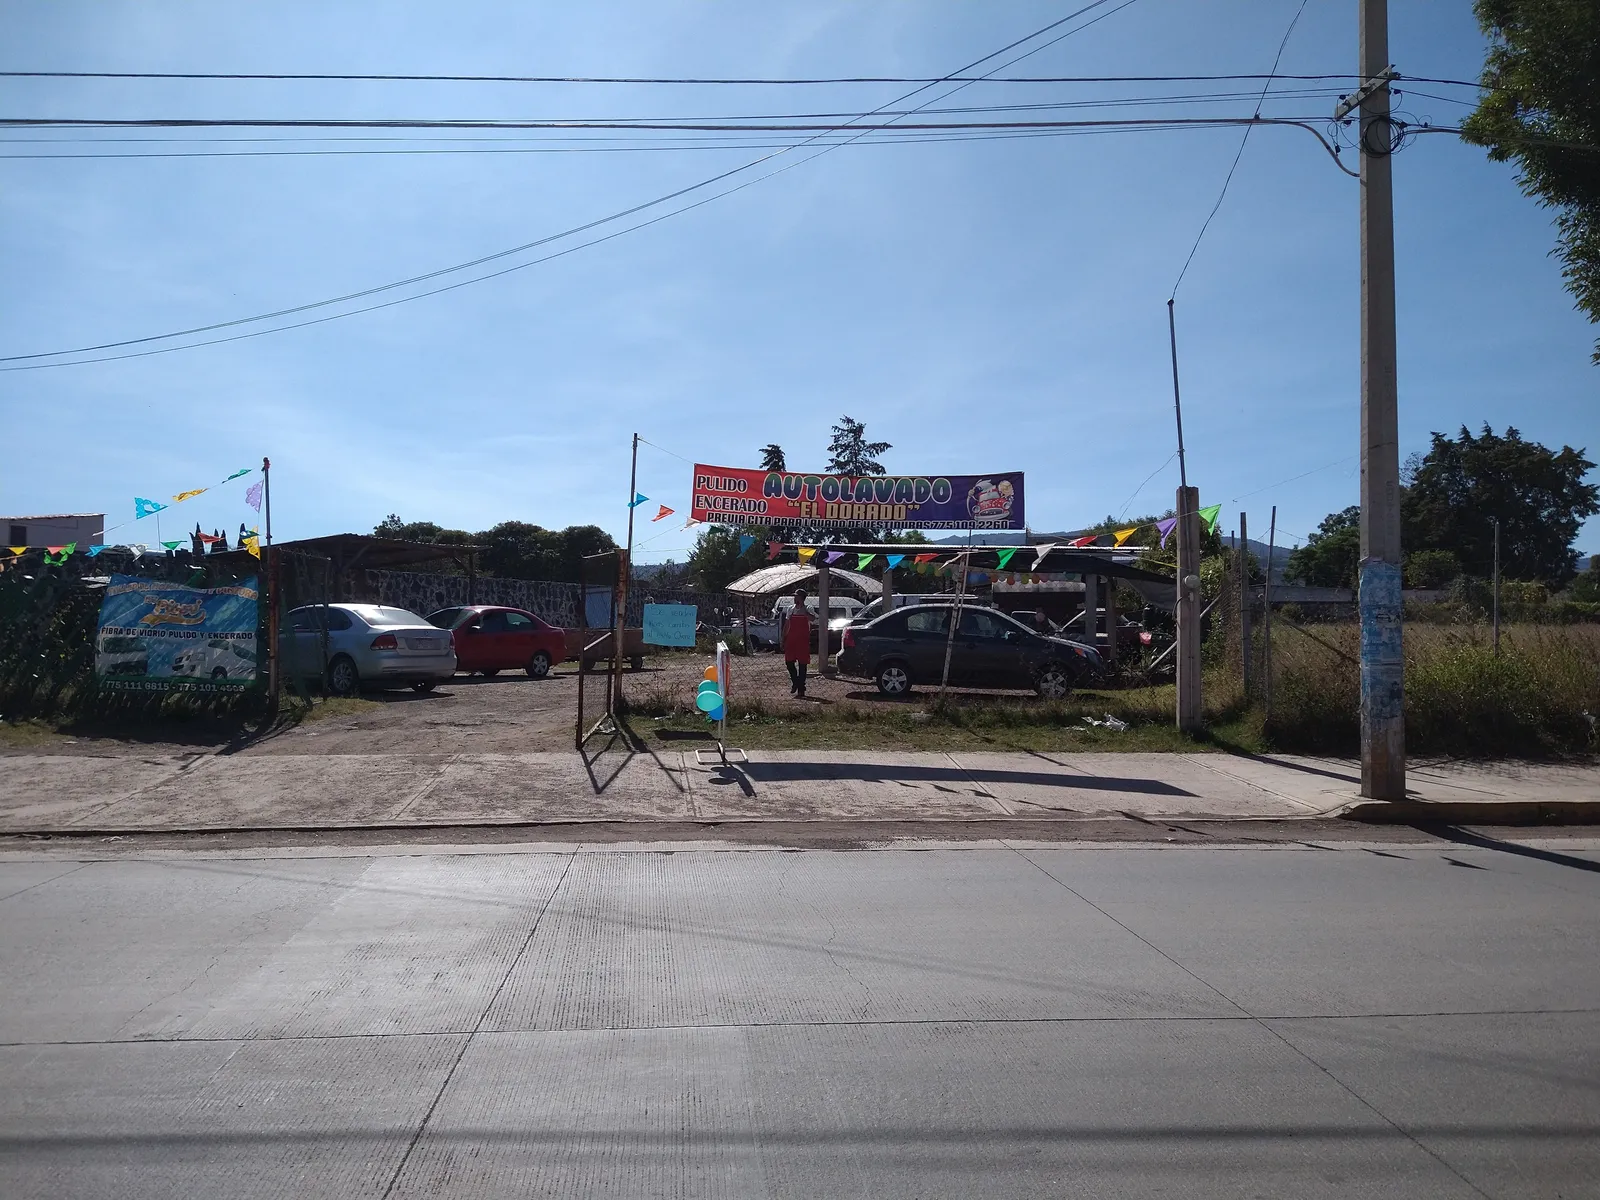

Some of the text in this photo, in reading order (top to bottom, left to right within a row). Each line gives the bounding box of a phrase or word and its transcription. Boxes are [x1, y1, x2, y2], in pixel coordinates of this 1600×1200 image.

[696, 474, 748, 493] PULIDO
[763, 472, 952, 504] AUTOLAVADO
[695, 494, 768, 514] ENCERADO
[707, 511, 745, 524] PREVIA
[747, 514, 772, 526] CITA
[774, 516, 804, 527] PARA
[804, 517, 847, 528] LAVADO
[864, 519, 932, 529] VESTIDURAS
[932, 519, 954, 529] 775
[977, 519, 1009, 529] 2260
[101, 627, 124, 636] FIBRA
[126, 628, 136, 636] DE
[139, 629, 166, 638] VIDRIO
[168, 631, 197, 639] PULIDO
[208, 632, 253, 640] ENCERADO
[123, 681, 142, 690] 111
[178, 683, 197, 692] 775
[199, 683, 218, 692] 101
